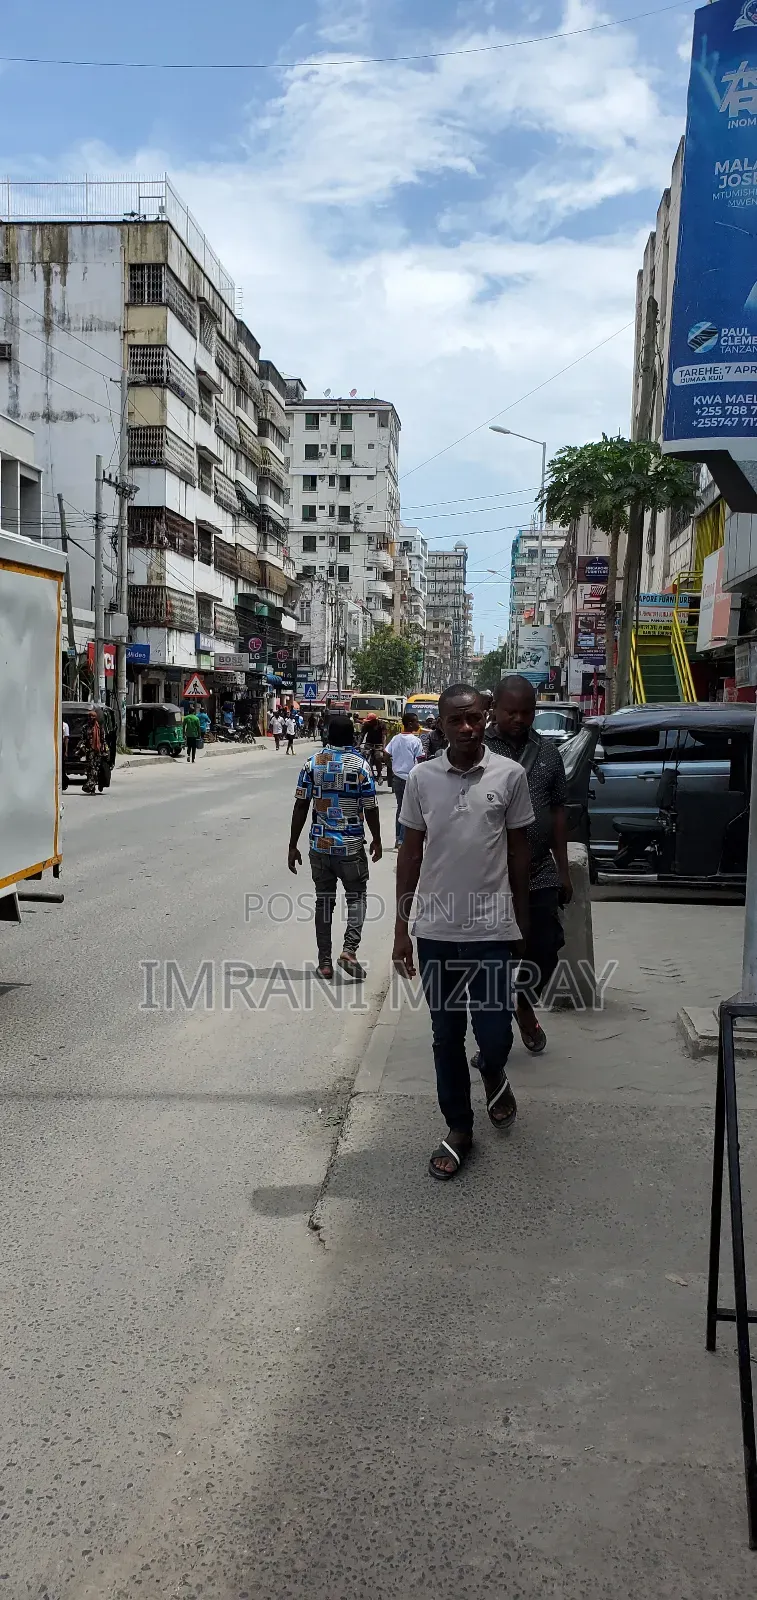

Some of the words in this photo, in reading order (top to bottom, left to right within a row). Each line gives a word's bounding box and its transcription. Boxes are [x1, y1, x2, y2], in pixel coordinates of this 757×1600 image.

[721, 328, 750, 336] PAUL
[679, 366, 722, 377] TAREHE:
[725, 366, 732, 374] 7
[693, 396, 722, 405] KWA
[695, 406, 722, 416] +255
[725, 406, 747, 415] 788
[692, 418, 739, 427] +255747
[659, 595, 691, 603] FURNURE
